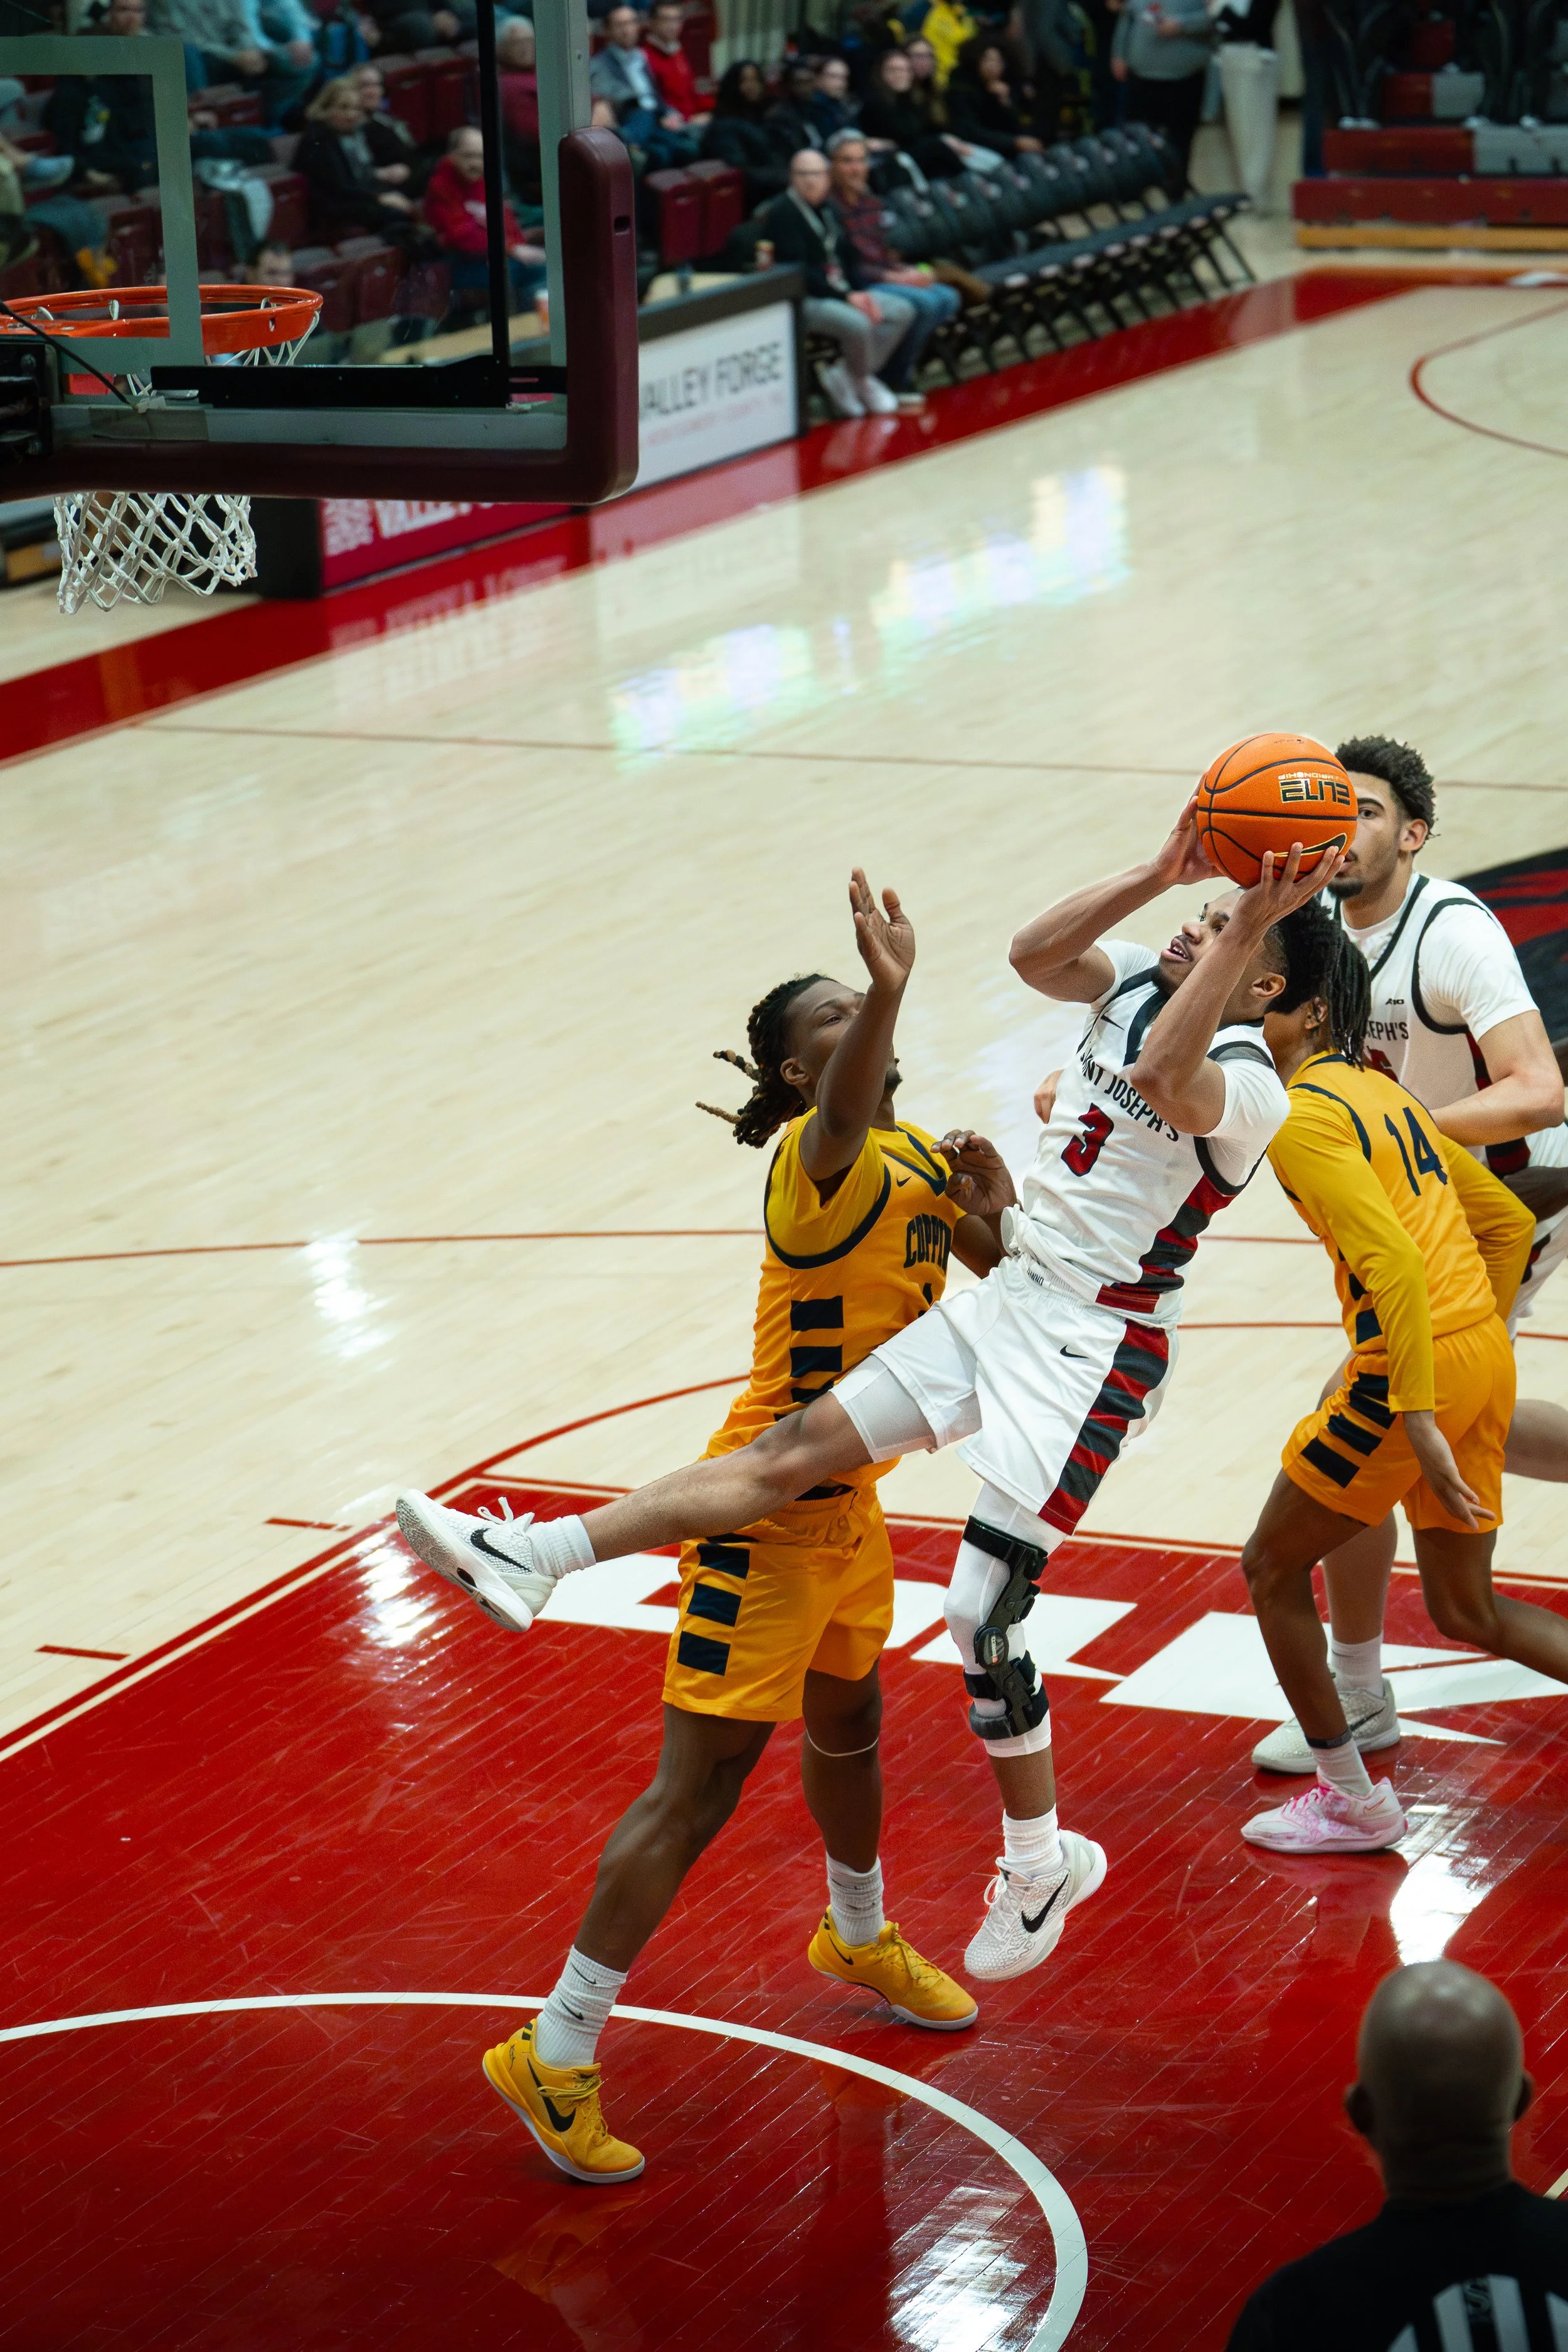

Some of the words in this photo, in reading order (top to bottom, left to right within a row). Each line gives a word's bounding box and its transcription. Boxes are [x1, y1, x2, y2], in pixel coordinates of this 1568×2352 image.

[638, 366, 711, 422] ALLEY
[714, 341, 781, 399] FORGE
[1279, 778, 1350, 806] ELITE
[1367, 1020, 1409, 1041] EPH'S
[1061, 1103, 1114, 1177] 3
[1384, 1107, 1448, 1197] 14
